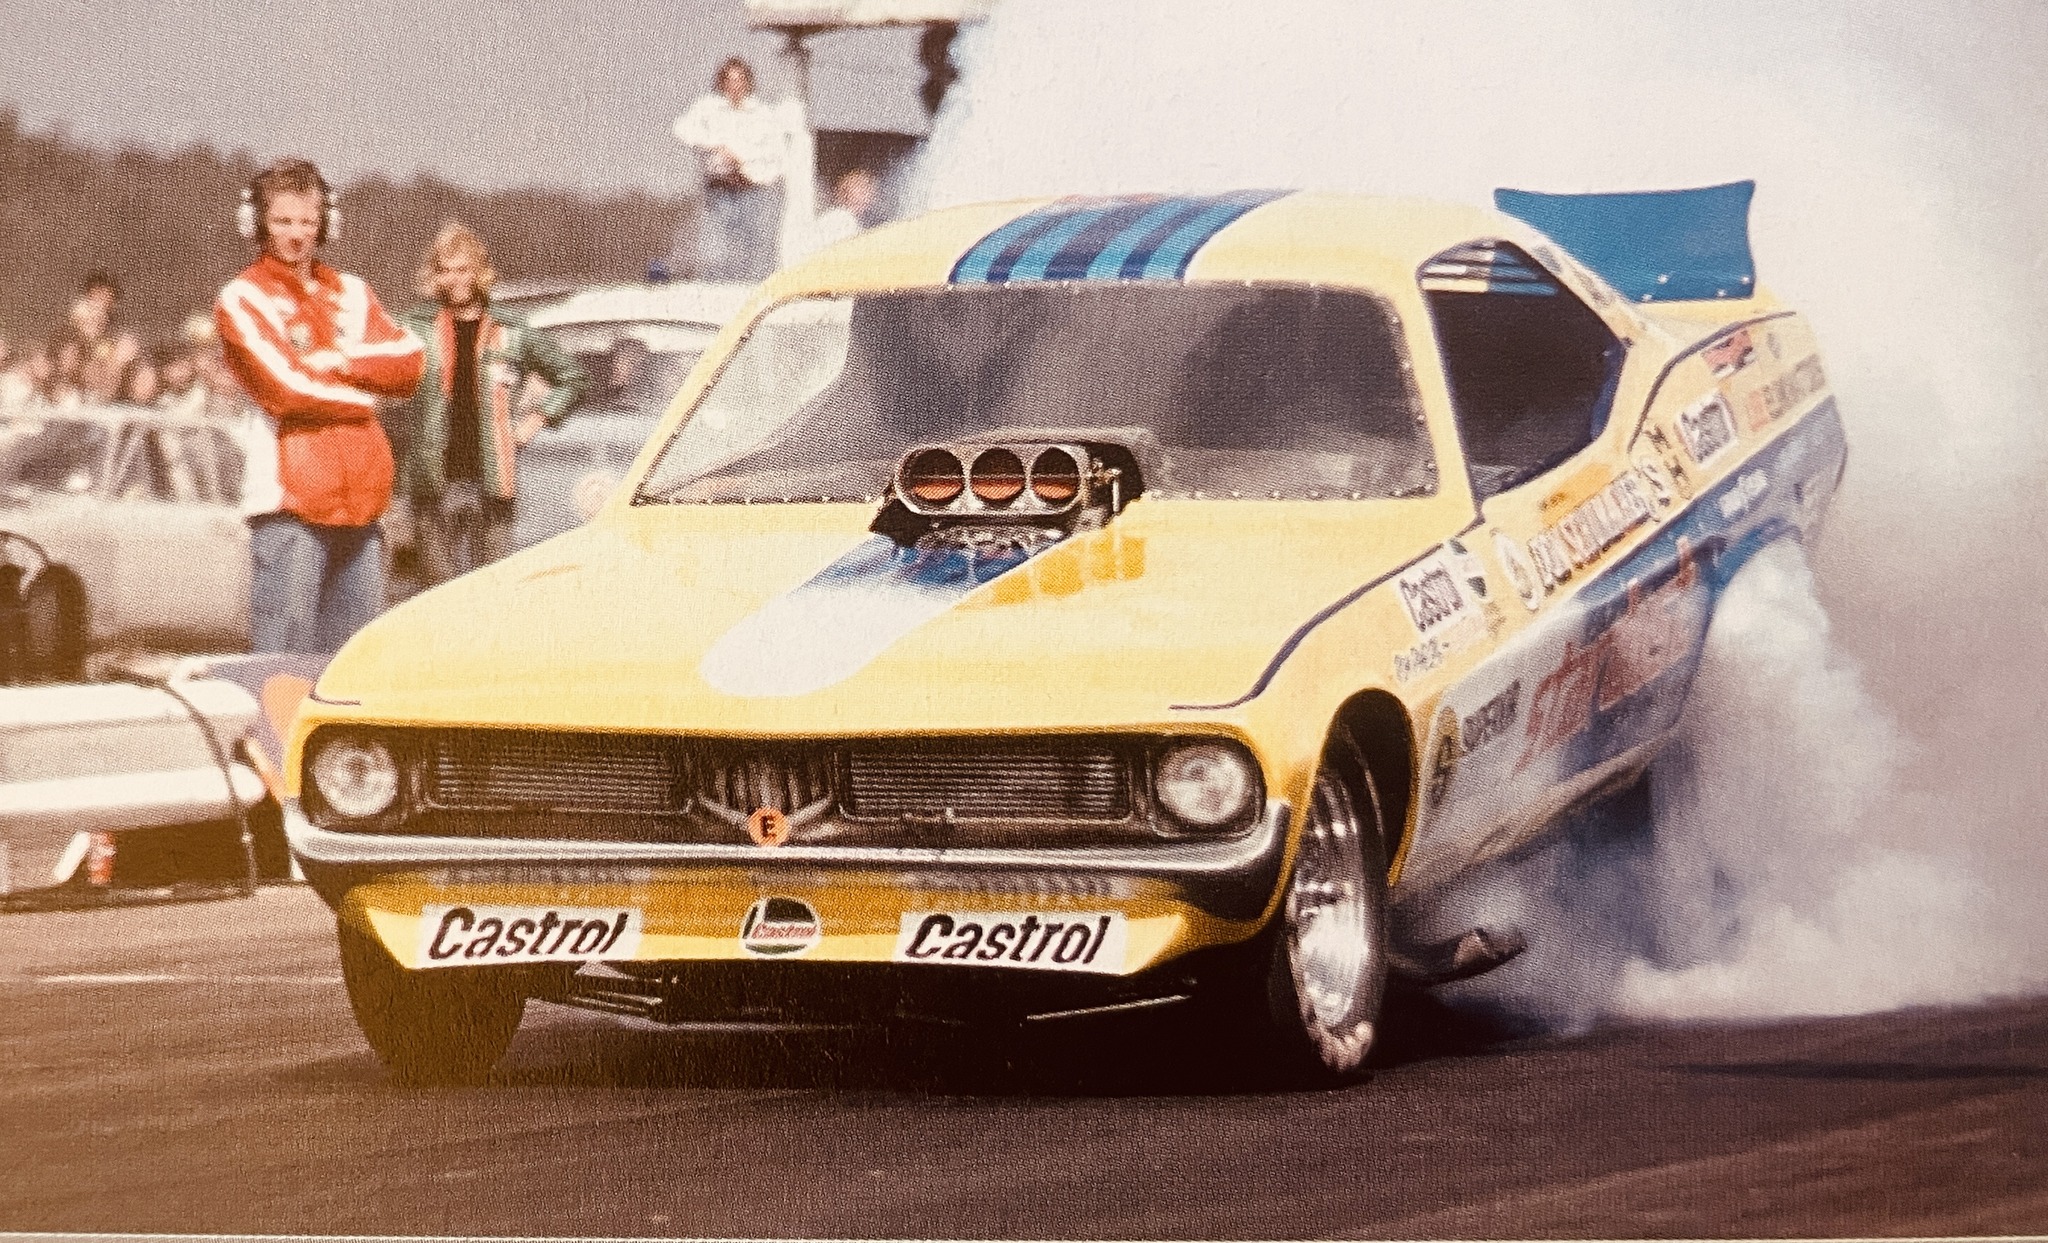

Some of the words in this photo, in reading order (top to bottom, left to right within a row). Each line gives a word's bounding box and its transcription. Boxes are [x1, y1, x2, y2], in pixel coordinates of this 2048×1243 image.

[759, 815, 777, 838] E
[428, 907, 628, 960] Castrol
[905, 914, 1111, 965] Castrol
